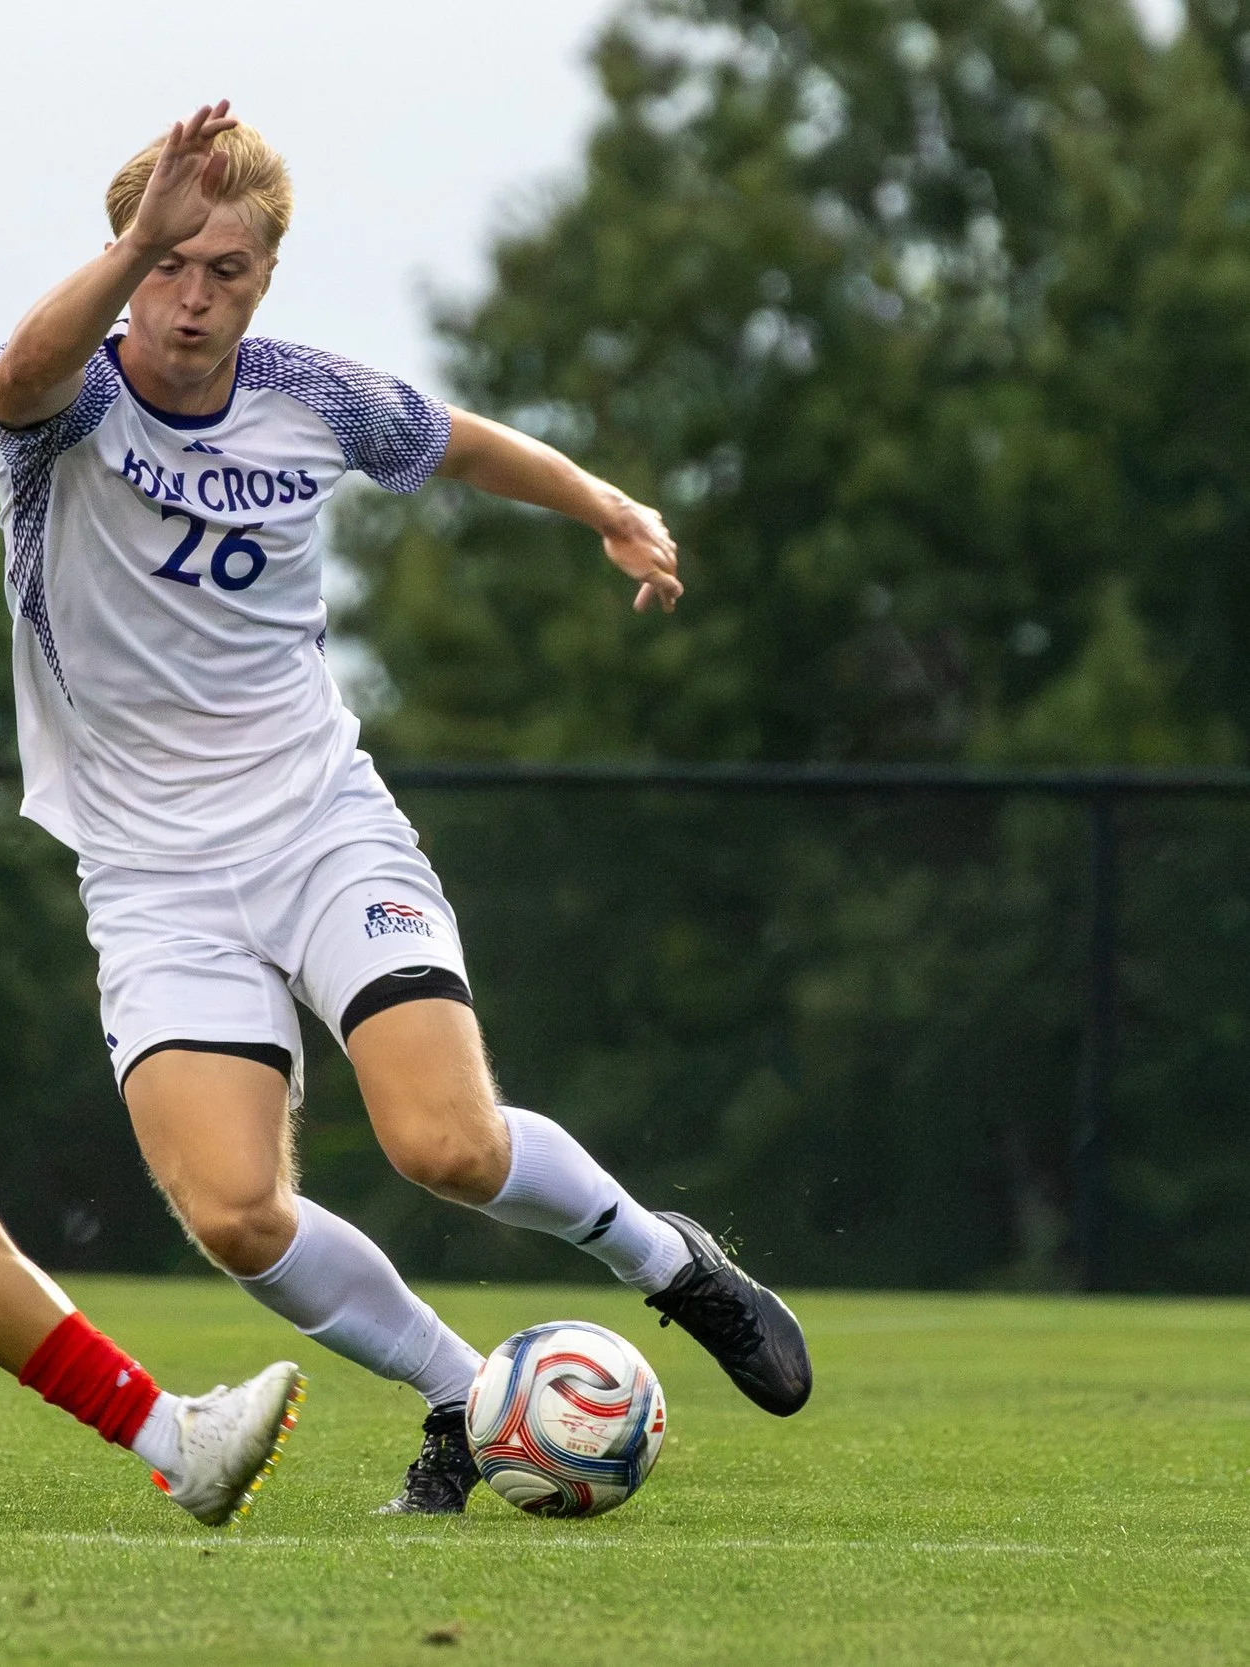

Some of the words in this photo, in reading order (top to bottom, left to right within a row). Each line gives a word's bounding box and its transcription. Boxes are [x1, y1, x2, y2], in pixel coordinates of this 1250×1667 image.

[197, 467, 318, 512] CROSS
[150, 504, 268, 591] 26
[367, 925, 435, 939] LEAGUE
